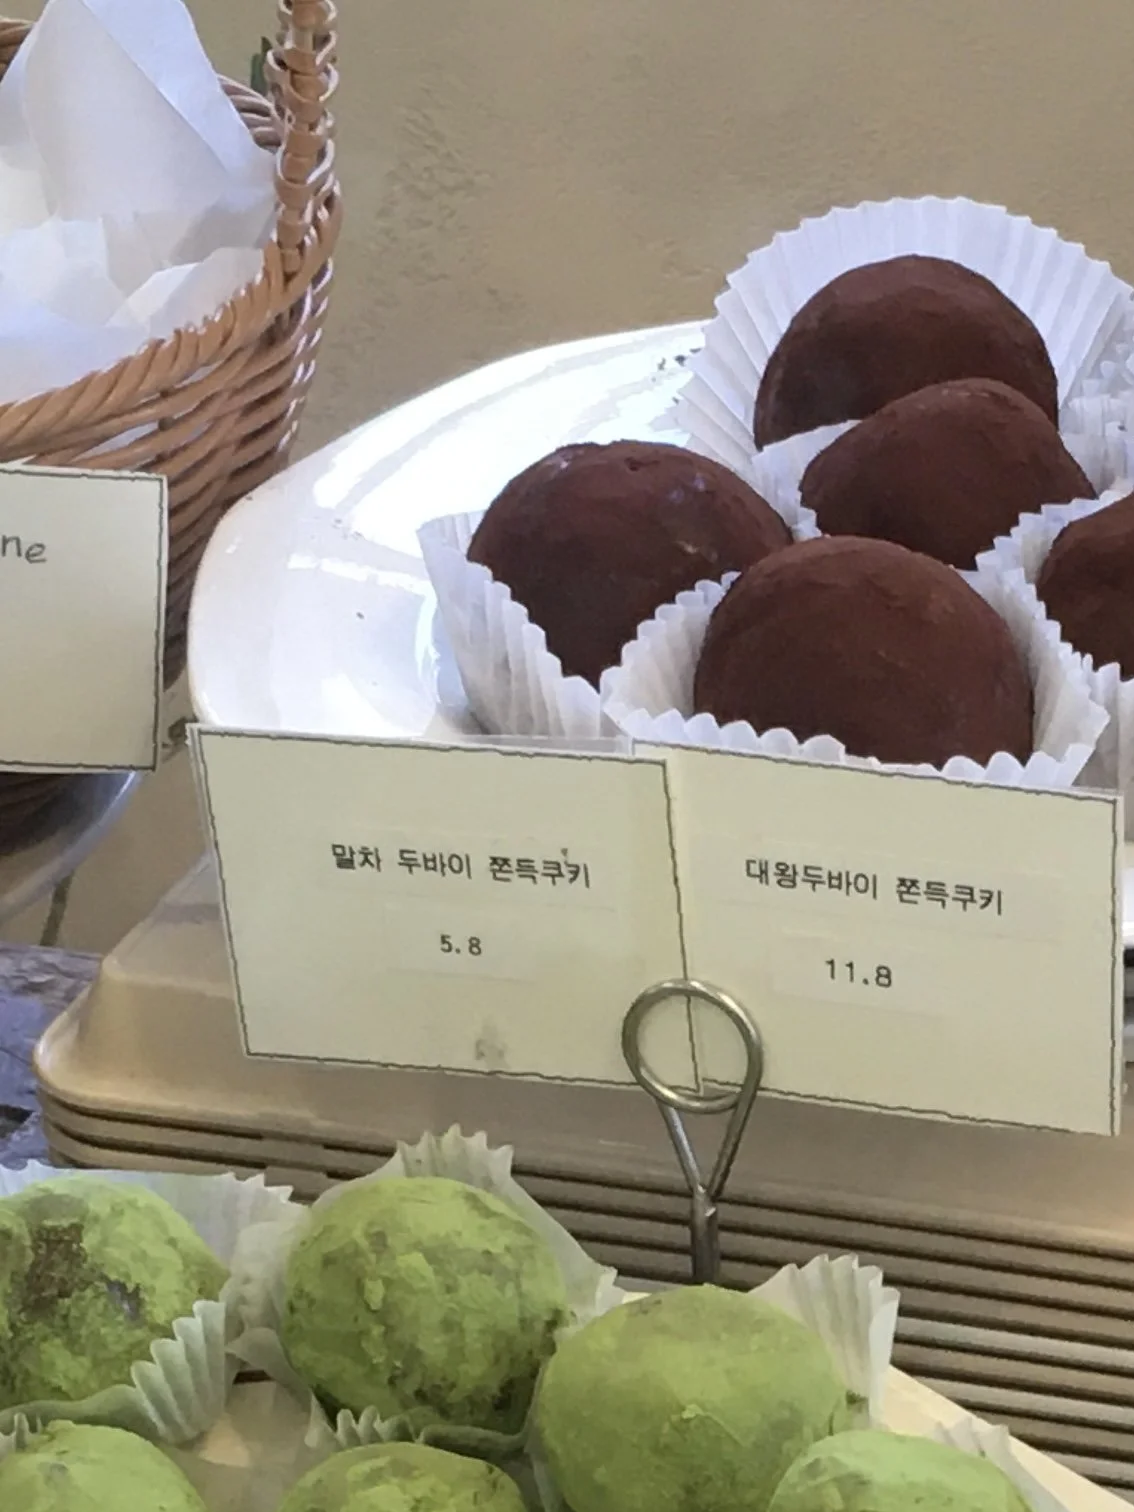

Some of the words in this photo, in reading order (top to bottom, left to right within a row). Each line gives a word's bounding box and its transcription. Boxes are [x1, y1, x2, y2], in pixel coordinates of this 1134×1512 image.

[330, 843, 382, 873] 말차
[397, 848, 473, 880] 두바이
[488, 855, 591, 889] 쫀득쿠키
[744, 858, 878, 901] 대왕두바이
[895, 875, 1003, 916] 쫀득쿠키
[439, 934, 483, 956] 5.8
[824, 958, 893, 988] 11.8
